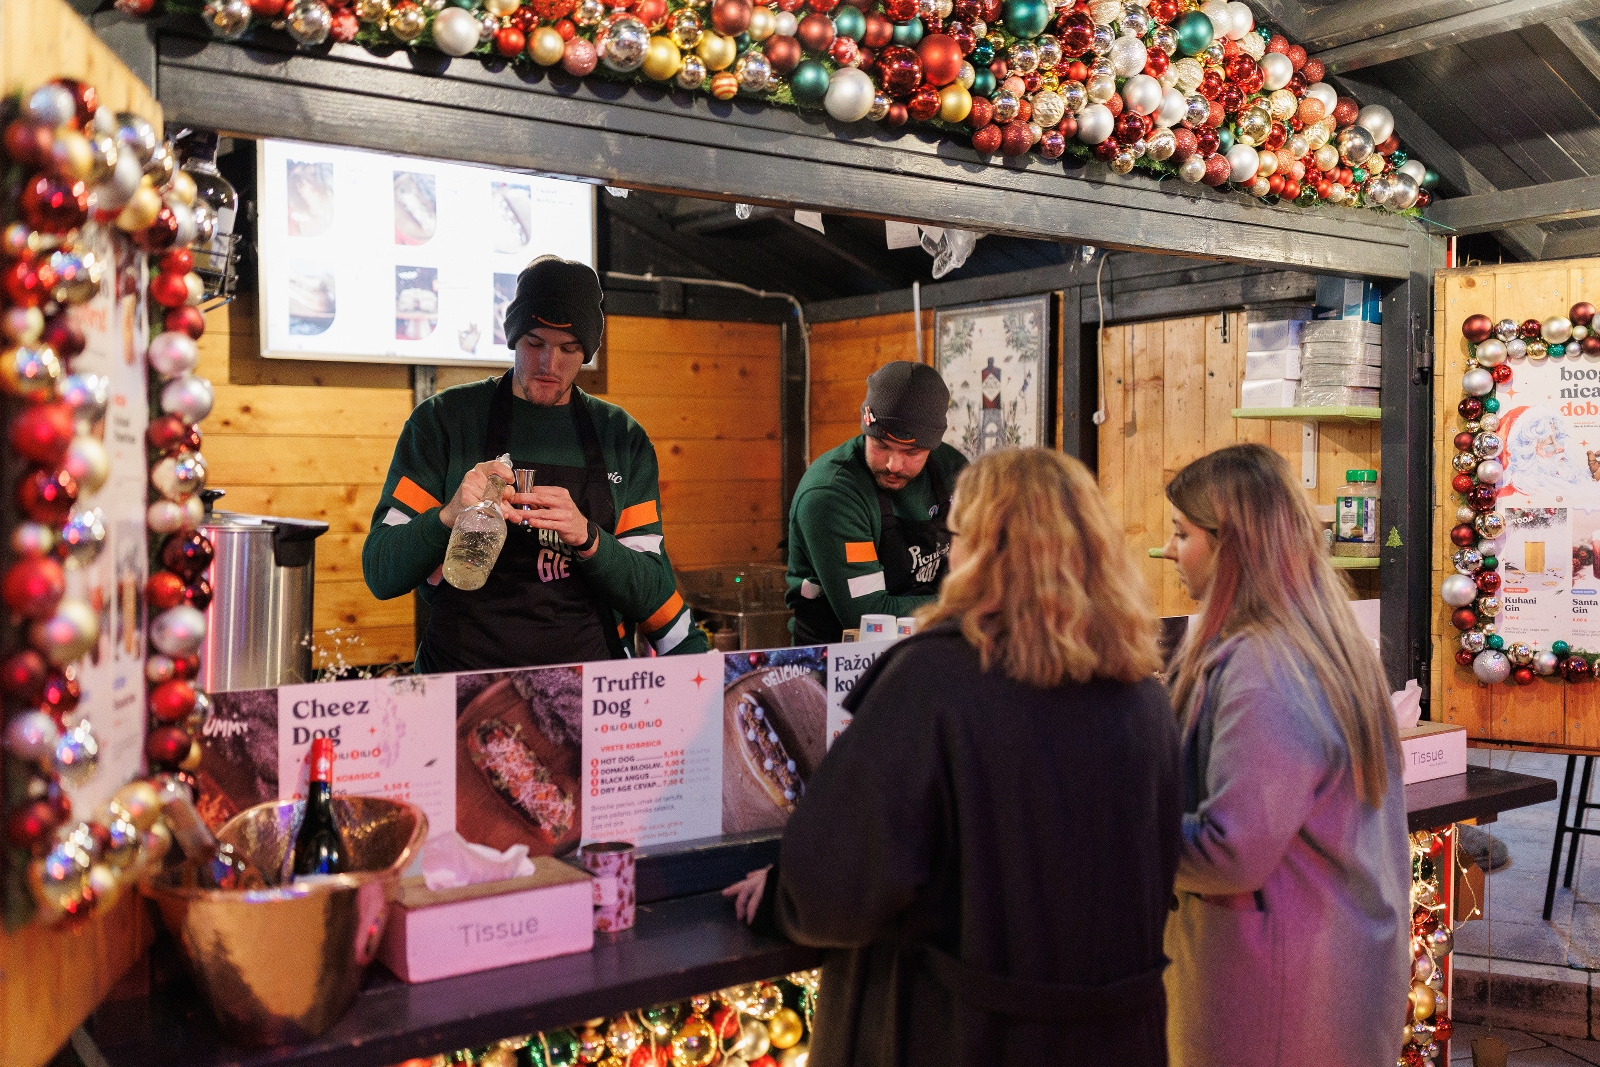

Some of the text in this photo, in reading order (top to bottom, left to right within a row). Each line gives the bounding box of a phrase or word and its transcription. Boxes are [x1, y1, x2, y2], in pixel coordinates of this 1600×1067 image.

[1560, 366, 1600, 382] boo
[1560, 401, 1600, 416] dob
[537, 548, 572, 582] GIE
[1504, 596, 1536, 604] Kuhani
[592, 671, 665, 693] Truffle
[761, 664, 811, 688] DELICIOUS
[292, 698, 370, 719] Cheez
[592, 698, 631, 718] Dog
[202, 719, 248, 738] UMMY
[618, 756, 635, 764] DOG
[1411, 749, 1444, 765] Tissue
[601, 777, 622, 785] BLACK
[625, 773, 649, 782] ANGUS
[601, 787, 615, 795] DRY
[617, 785, 631, 793] AGE
[458, 916, 539, 947] Tissue
